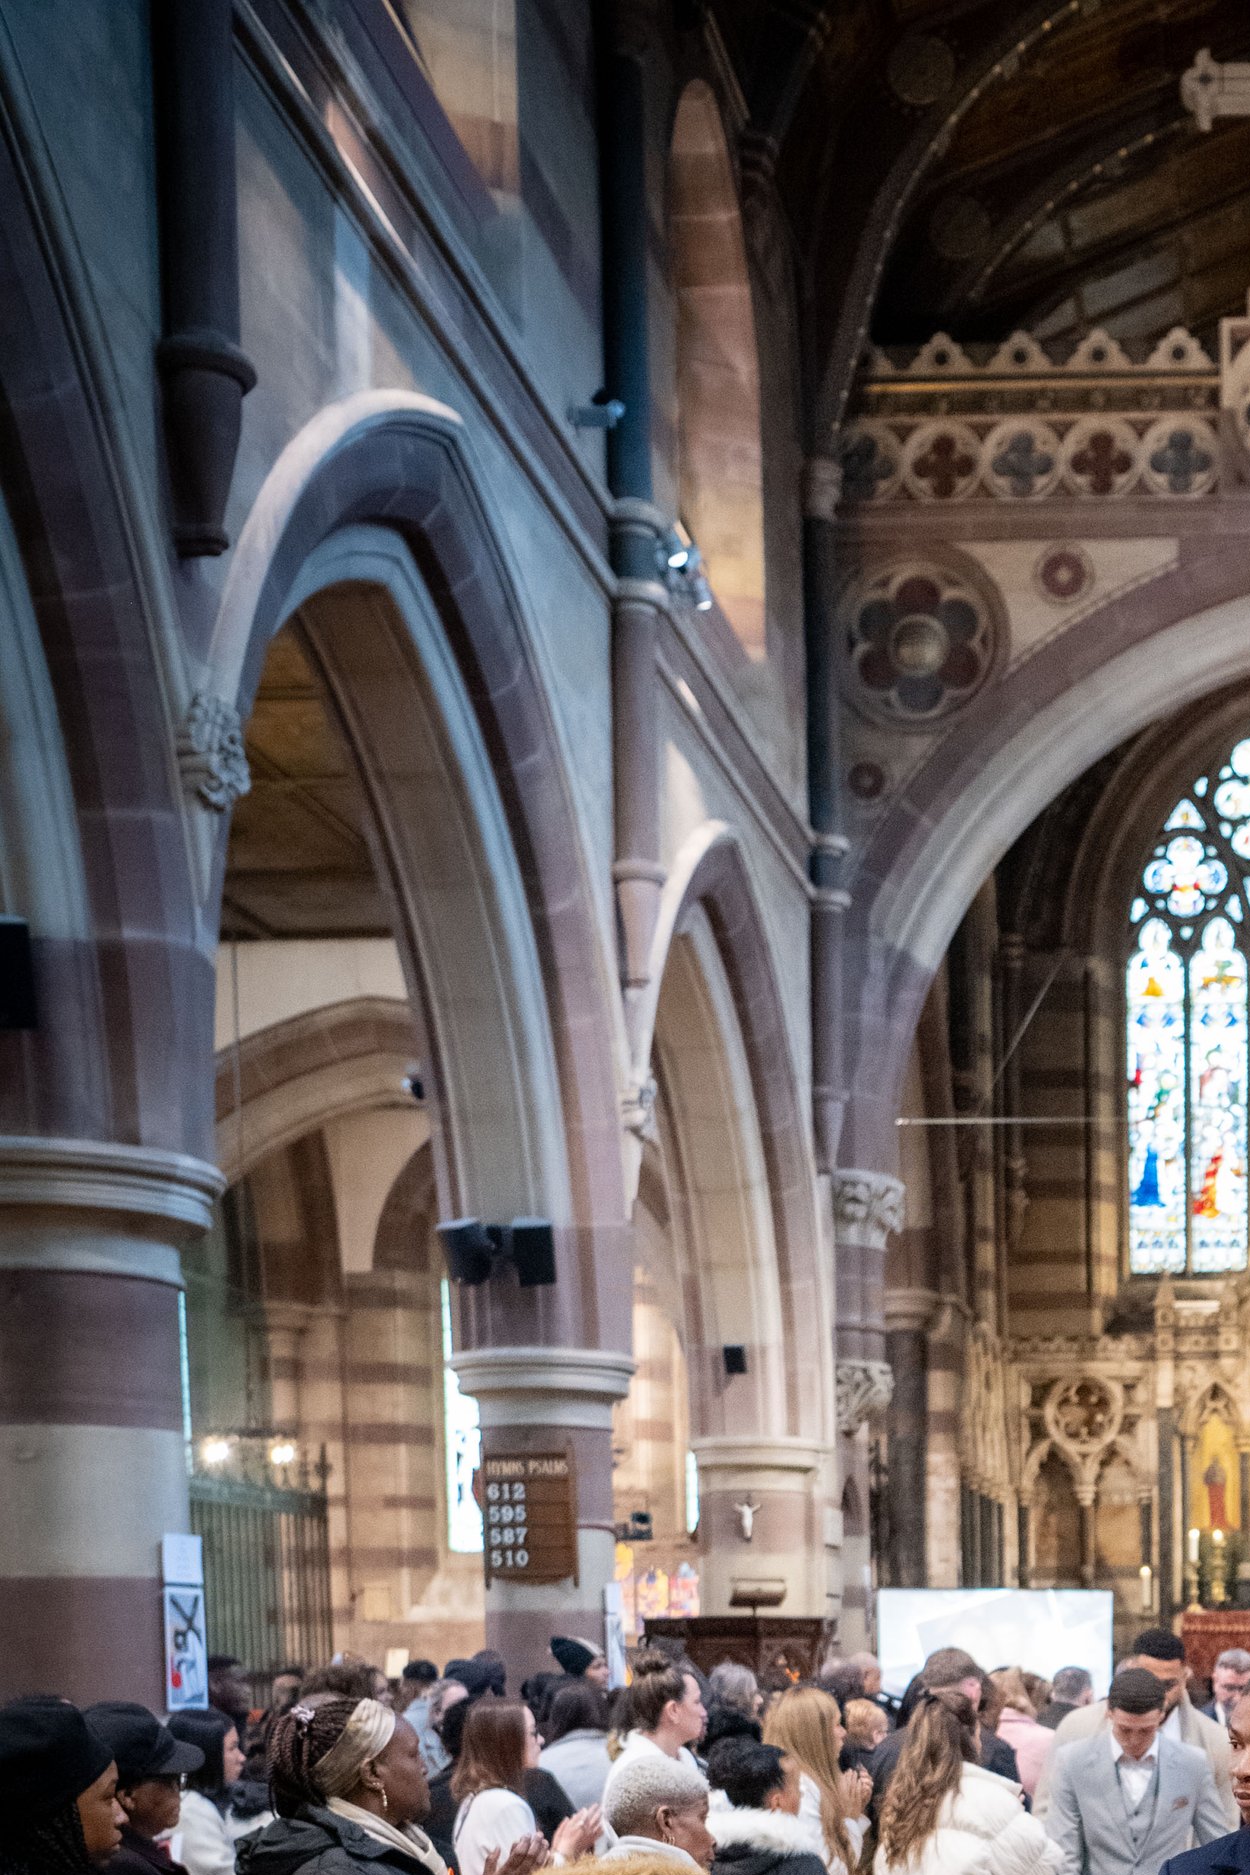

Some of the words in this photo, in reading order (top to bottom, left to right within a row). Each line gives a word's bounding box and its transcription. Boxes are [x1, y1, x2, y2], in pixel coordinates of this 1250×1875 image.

[486, 1460, 524, 1475] HYMNS
[529, 1460, 568, 1475] PSALMS
[487, 1482, 526, 1501] 612
[488, 1505, 526, 1523] 595
[490, 1527, 527, 1545] 587
[491, 1549, 529, 1568] 510
